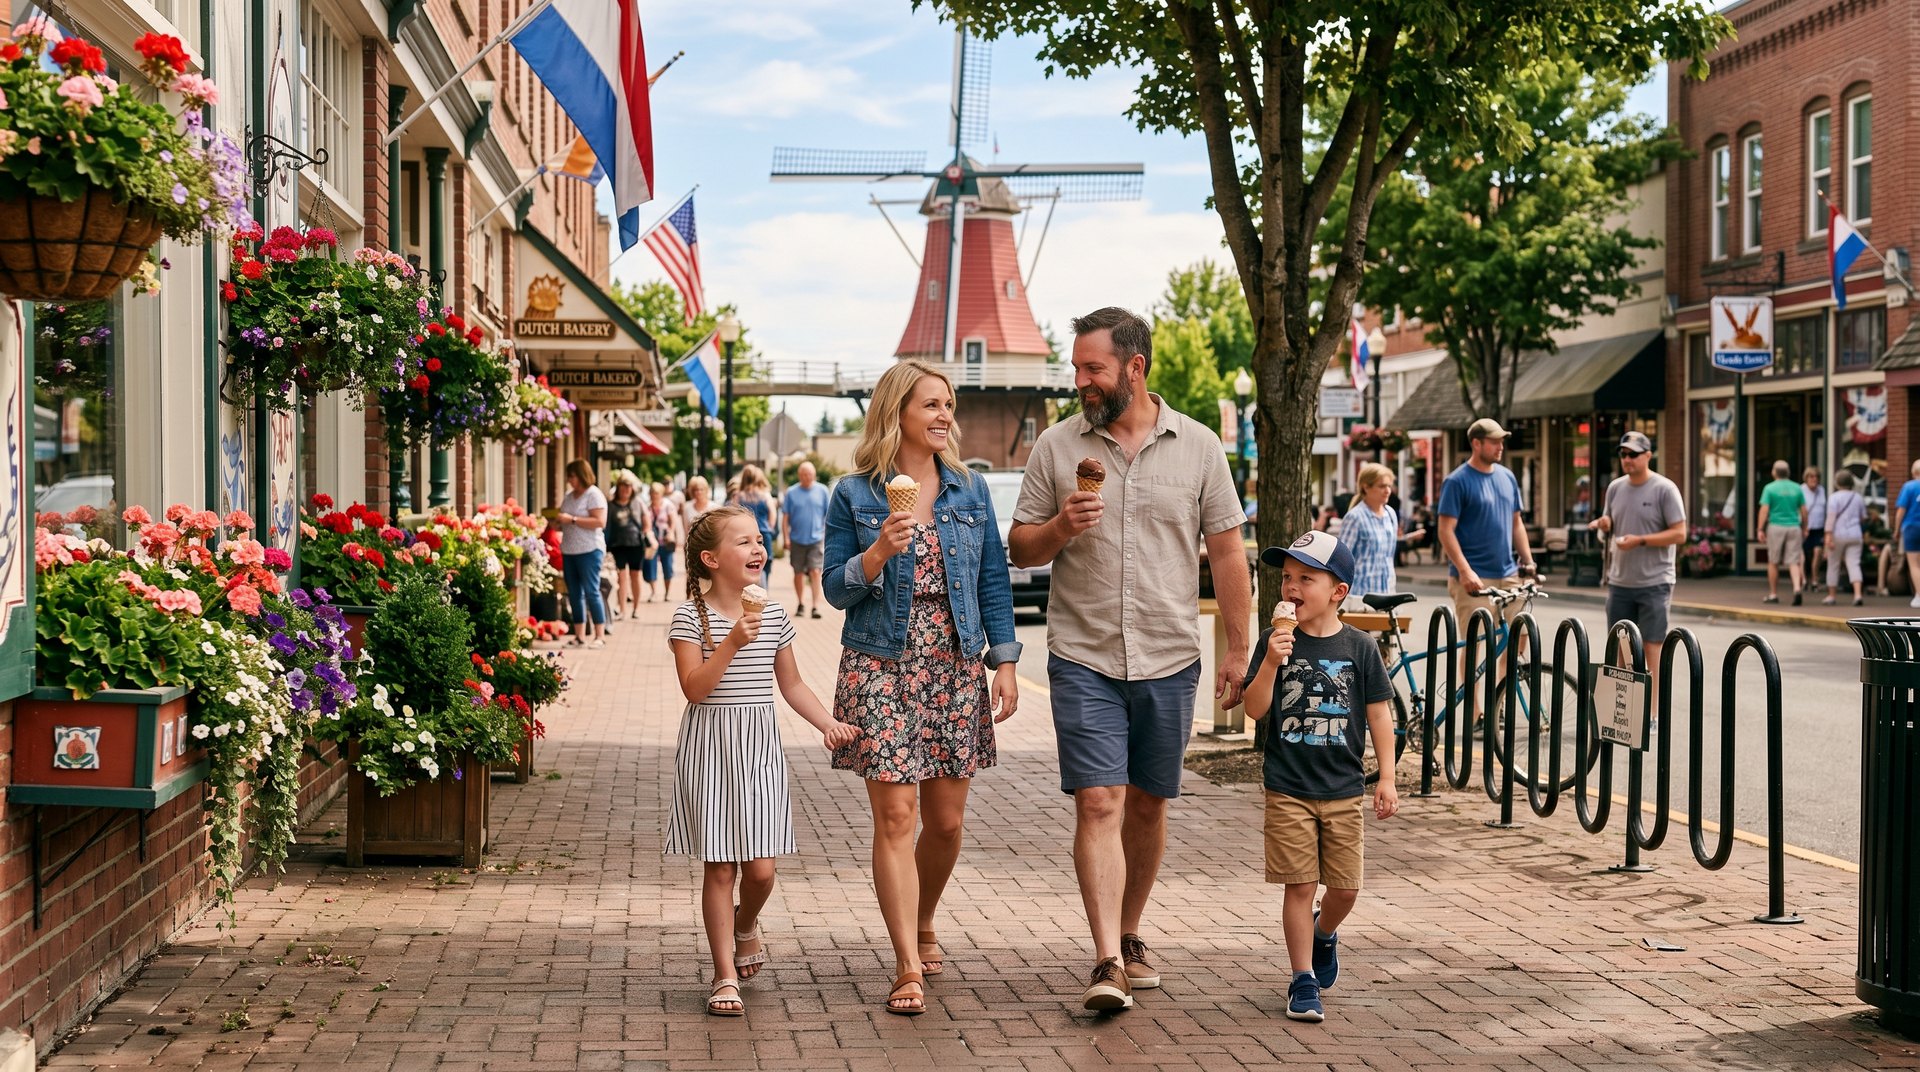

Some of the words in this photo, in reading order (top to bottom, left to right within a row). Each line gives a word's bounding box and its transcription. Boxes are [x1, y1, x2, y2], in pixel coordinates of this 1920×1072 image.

[518, 322, 560, 335] DUTCH
[563, 323, 611, 337] BAKERY
[551, 372, 590, 384] DUTCH
[593, 372, 638, 385] BAKERY
